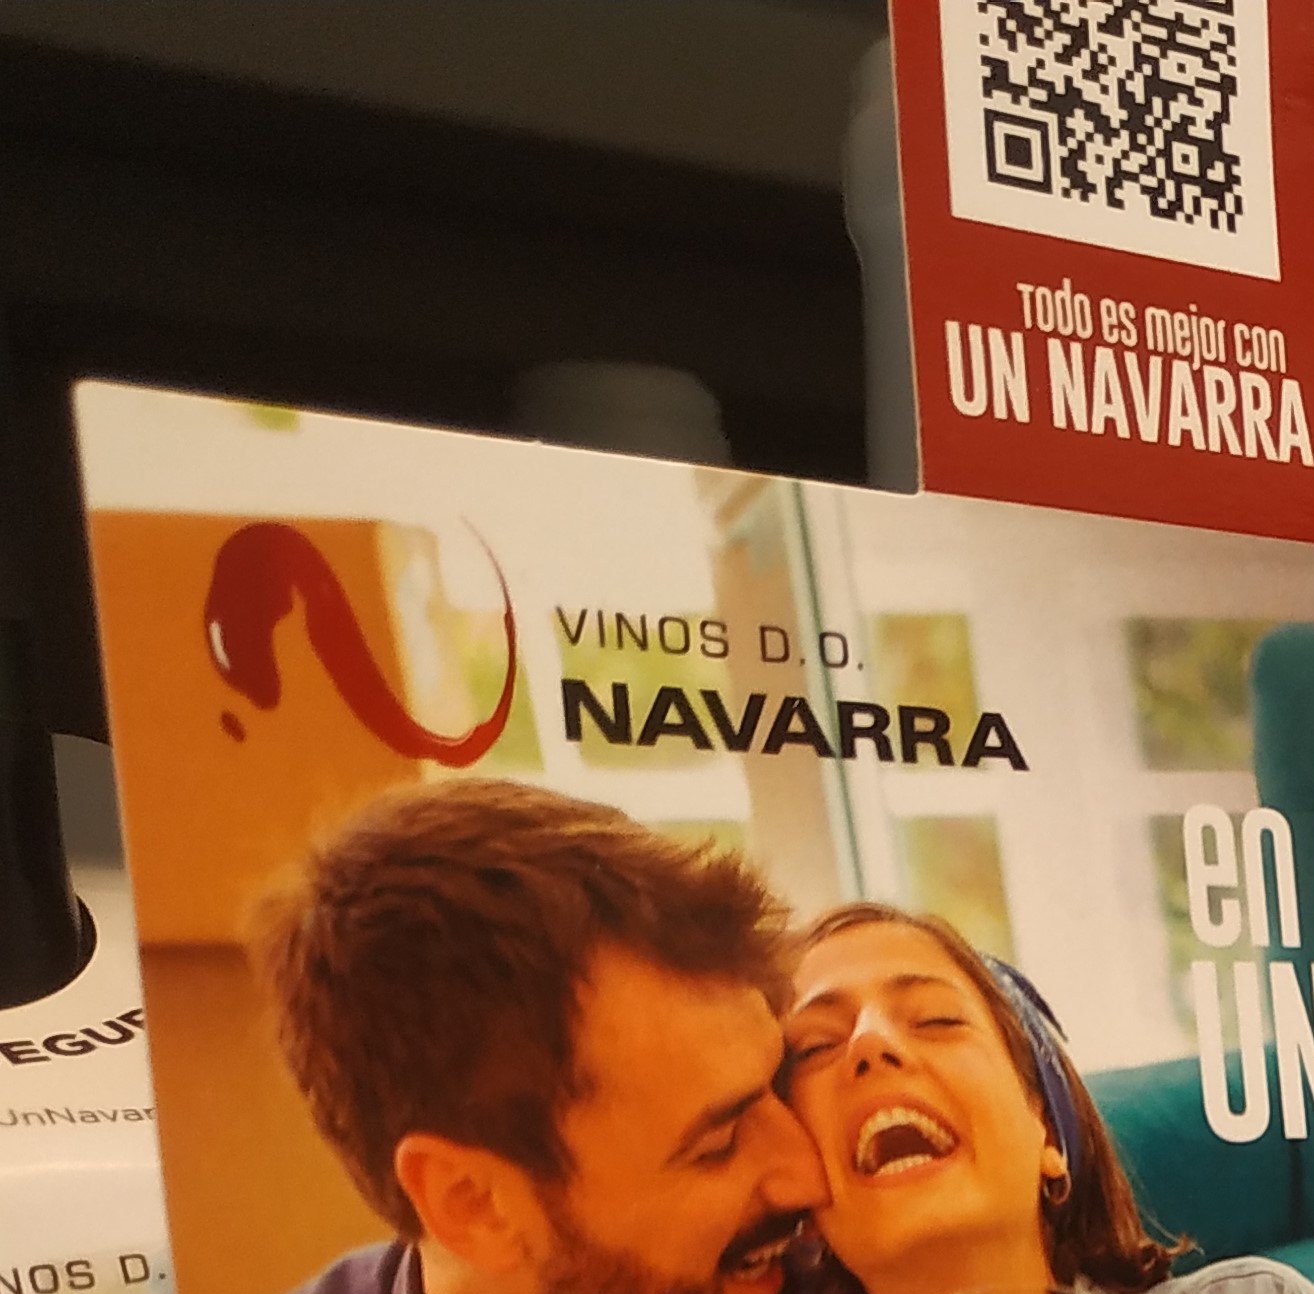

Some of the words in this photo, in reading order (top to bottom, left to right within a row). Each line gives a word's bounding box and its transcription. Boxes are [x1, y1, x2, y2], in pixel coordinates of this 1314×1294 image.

[1017, 278, 1092, 340] Todo
[1100, 298, 1137, 347] es
[1145, 304, 1225, 370] mejor
[1233, 322, 1287, 374] con
[944, 320, 1031, 424] UN
[1047, 337, 1314, 468] NAVARRA
[556, 605, 730, 659] VINOS
[760, 625, 865, 671] D.O.
[561, 678, 1030, 771] NAVARRA
[1183, 804, 1300, 949] en
